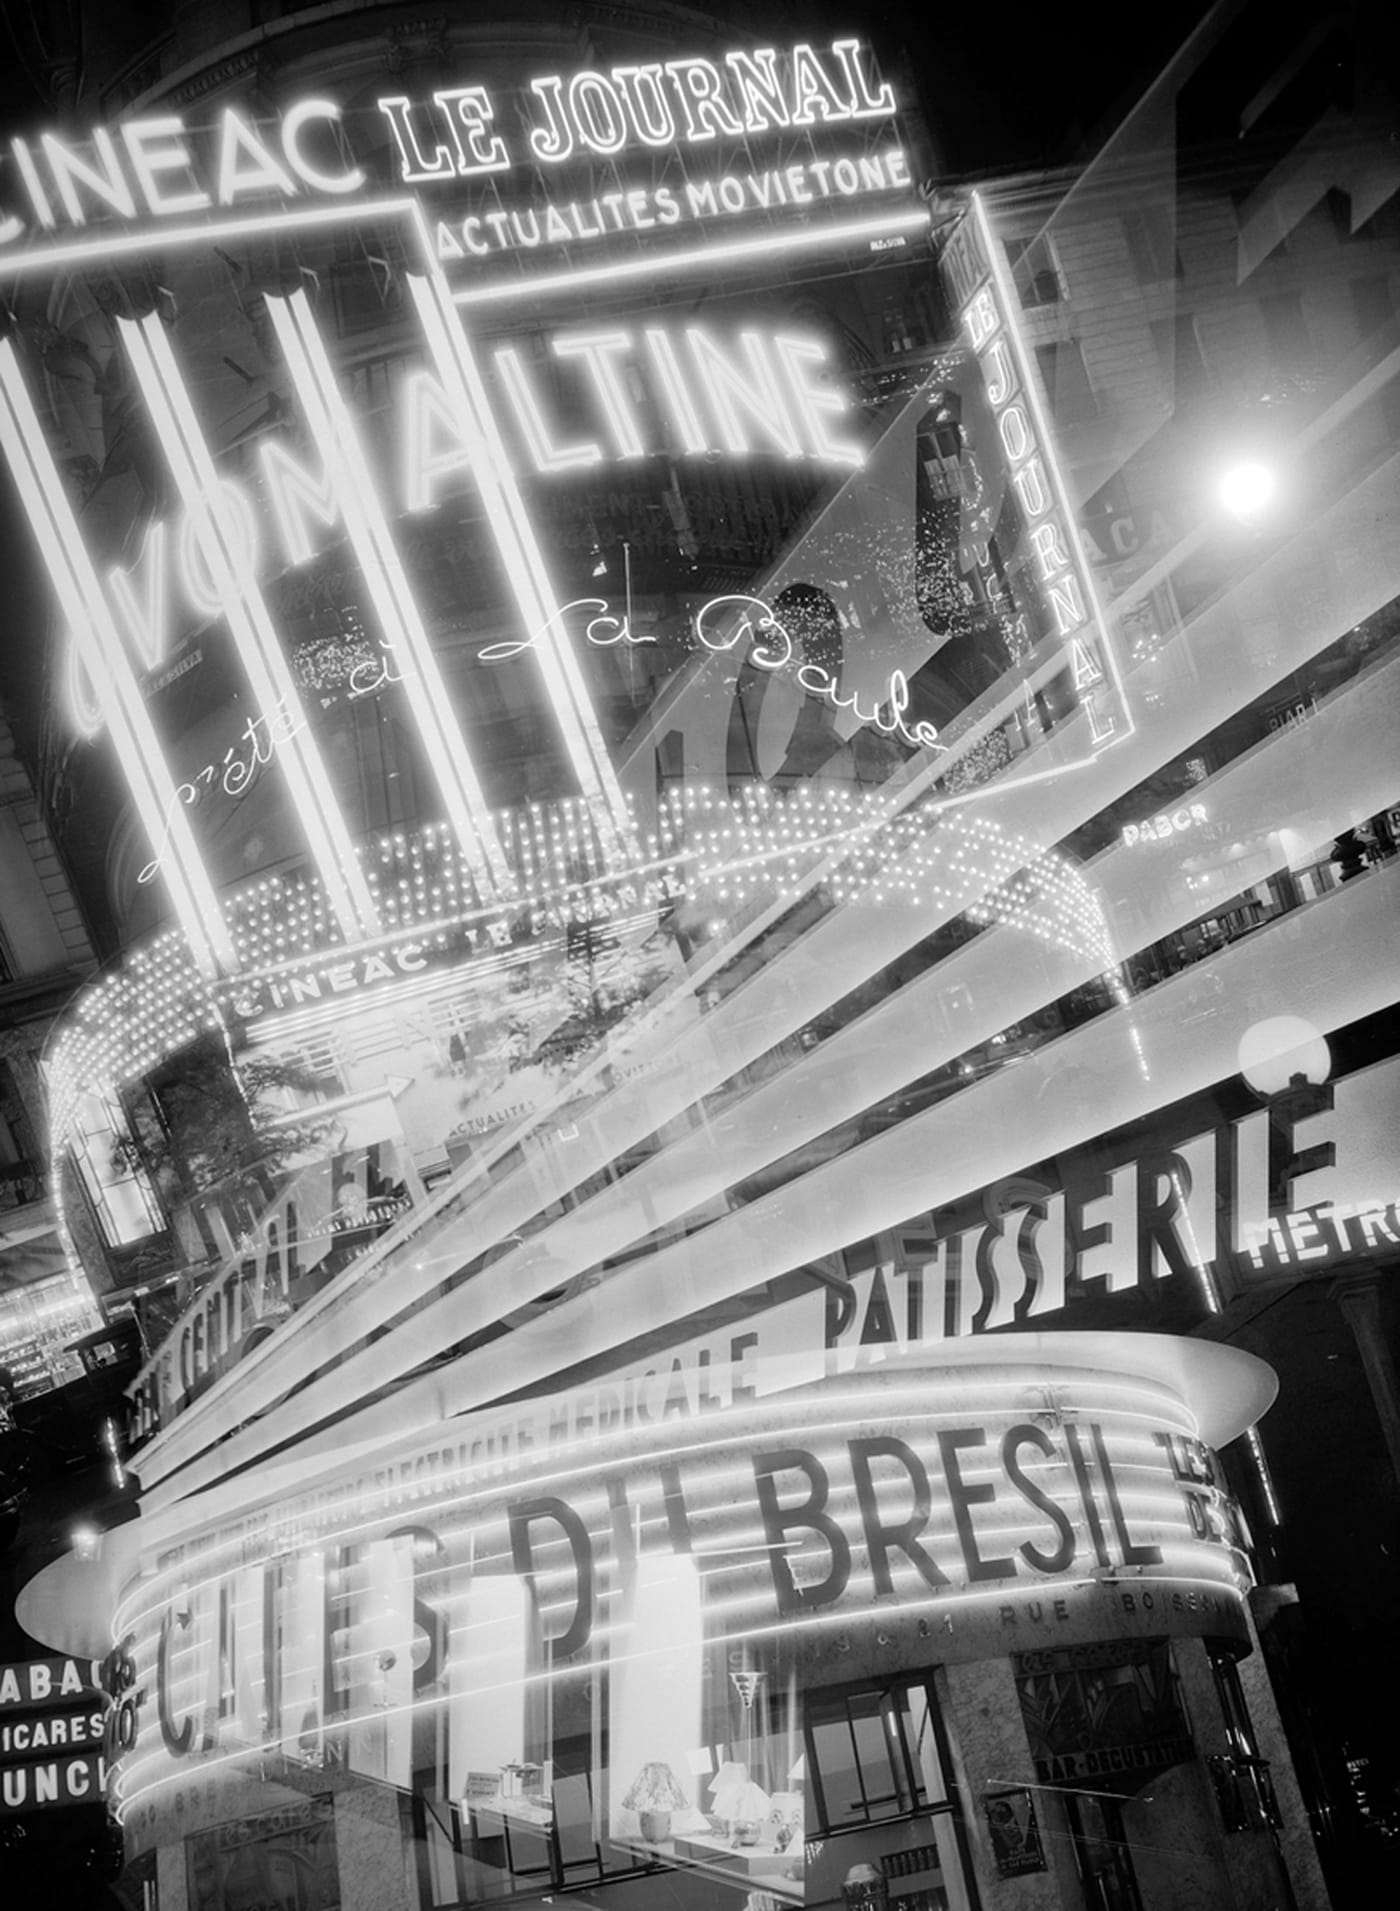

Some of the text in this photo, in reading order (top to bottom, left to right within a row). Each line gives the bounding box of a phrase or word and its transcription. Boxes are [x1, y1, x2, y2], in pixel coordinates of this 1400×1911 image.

[379, 38, 897, 183] LE JOURNAL
[435, 150, 912, 261] ACTUALITES MOVIETONE
[698, 594, 950, 752] Baule
[234, 943, 428, 1018] CINEAC
[1238, 1203, 1400, 1270] METR
[547, 1331, 759, 1459] MEDICALE
[752, 1421, 1165, 1612] BRESIL
[999, 1599, 1070, 1627] RUE
